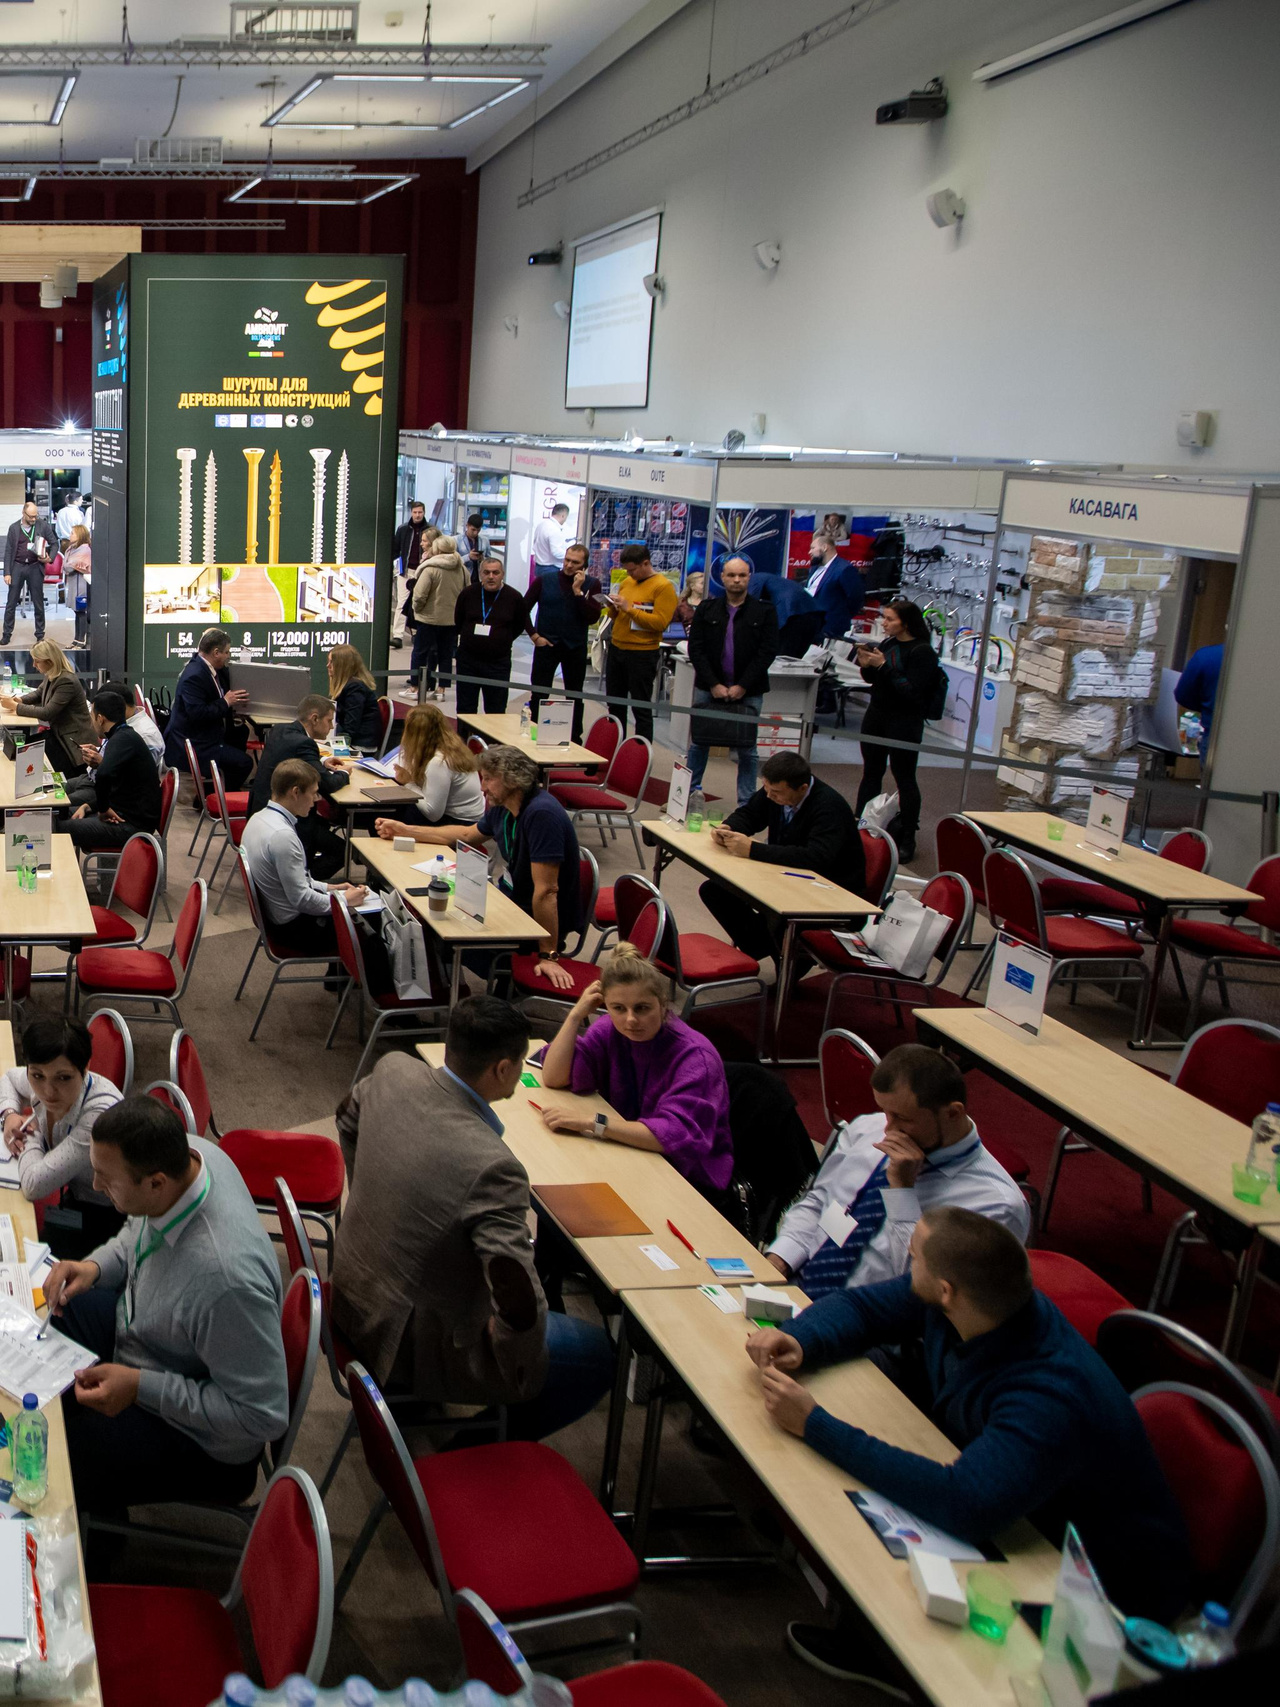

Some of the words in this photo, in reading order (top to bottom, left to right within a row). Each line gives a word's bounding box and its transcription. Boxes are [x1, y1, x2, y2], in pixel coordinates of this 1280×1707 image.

[244, 323, 286, 335] AMBROVIT
[222, 377, 278, 392] ШУРУПЫ
[280, 377, 308, 393] ДЛЯ
[178, 393, 261, 410] ДЕРЕВЯННЫХ
[263, 391, 351, 410] КОНСТРУКЦИЙ
[45, 449, 64, 457] ООО
[619, 466, 631, 478] ELKA
[651, 469, 665, 482] OUTE
[1069, 498, 1138, 520] КАСАВАГА
[178, 632, 193, 646] 54
[243, 632, 251, 646] 8
[271, 631, 309, 646] 12,000
[315, 631, 345, 646] 1,800
